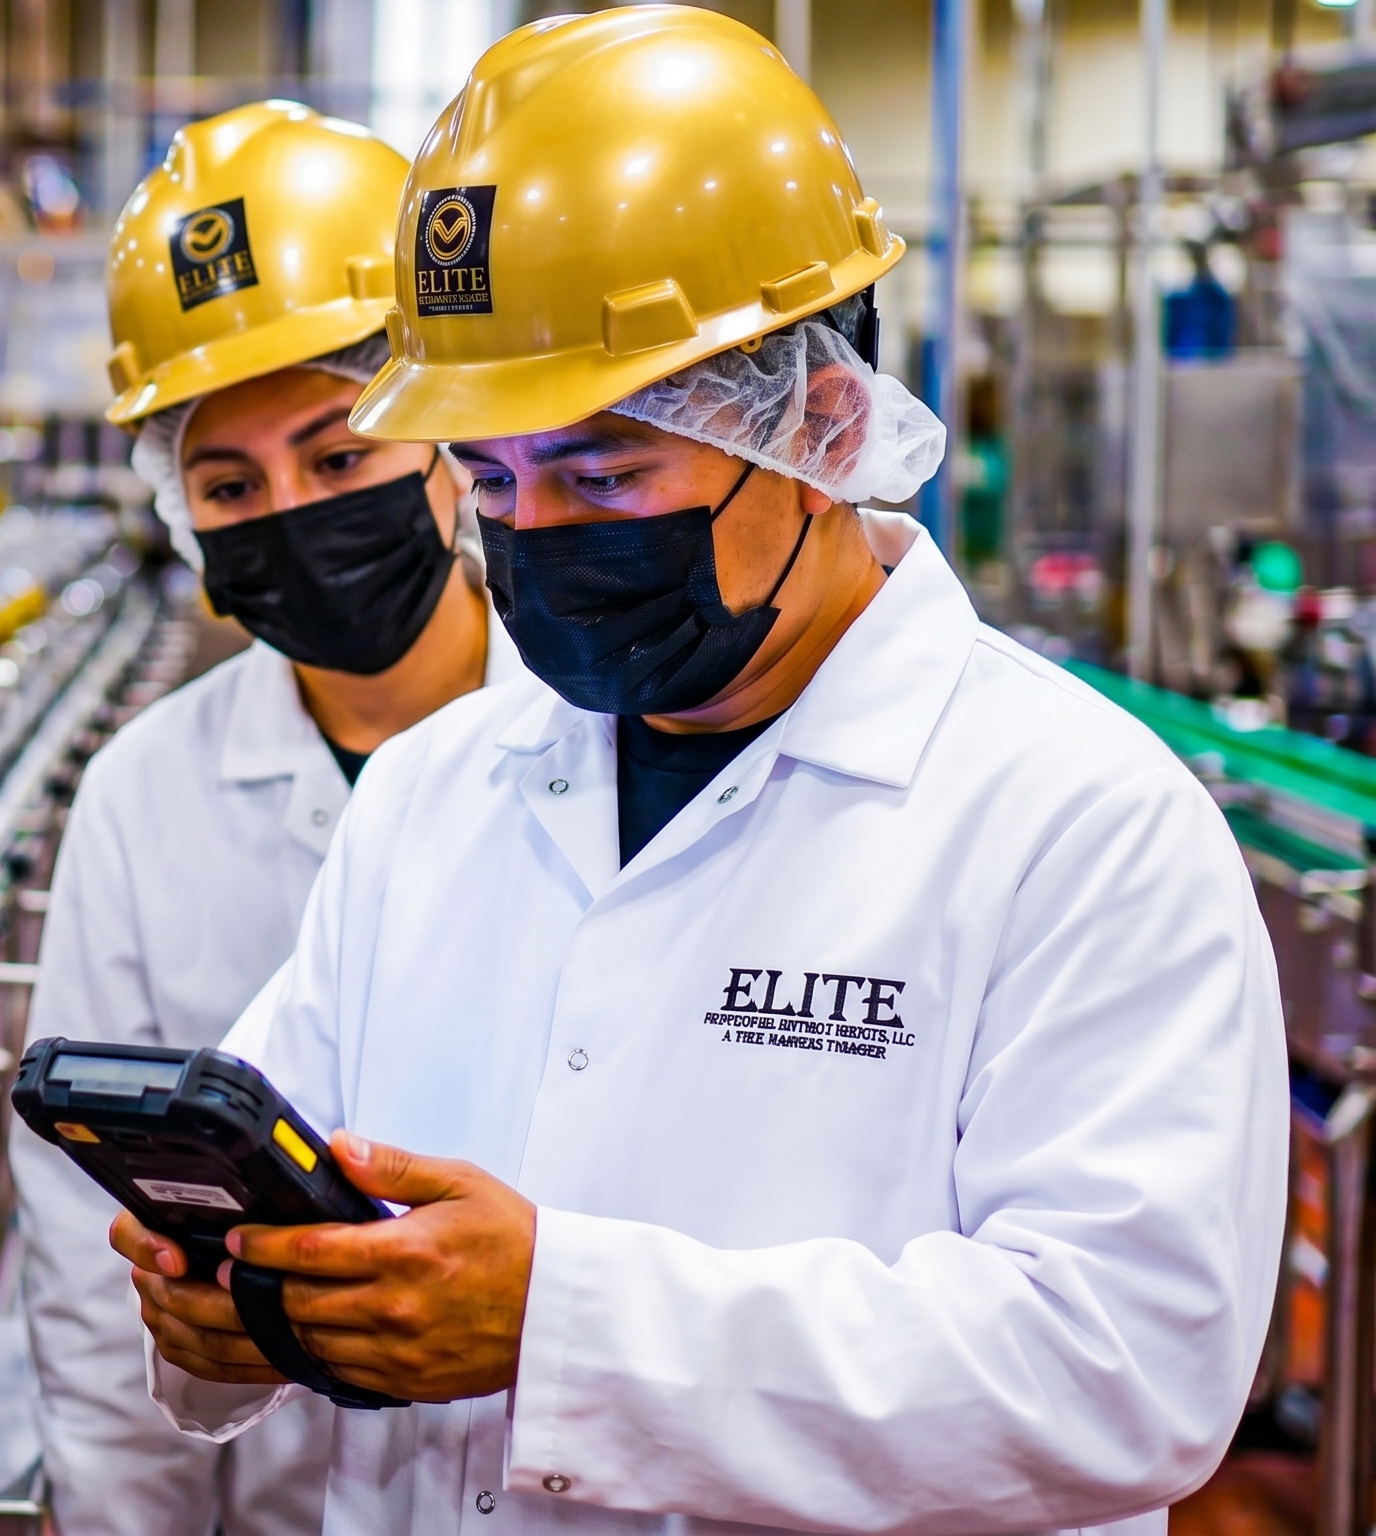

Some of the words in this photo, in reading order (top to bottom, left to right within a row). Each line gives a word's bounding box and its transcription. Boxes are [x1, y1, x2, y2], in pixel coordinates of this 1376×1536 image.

[418, 267, 486, 294] ELITE
[720, 968, 906, 1028] ELITE
[722, 1030, 732, 1042] A
[891, 1031, 916, 1046] LLC
